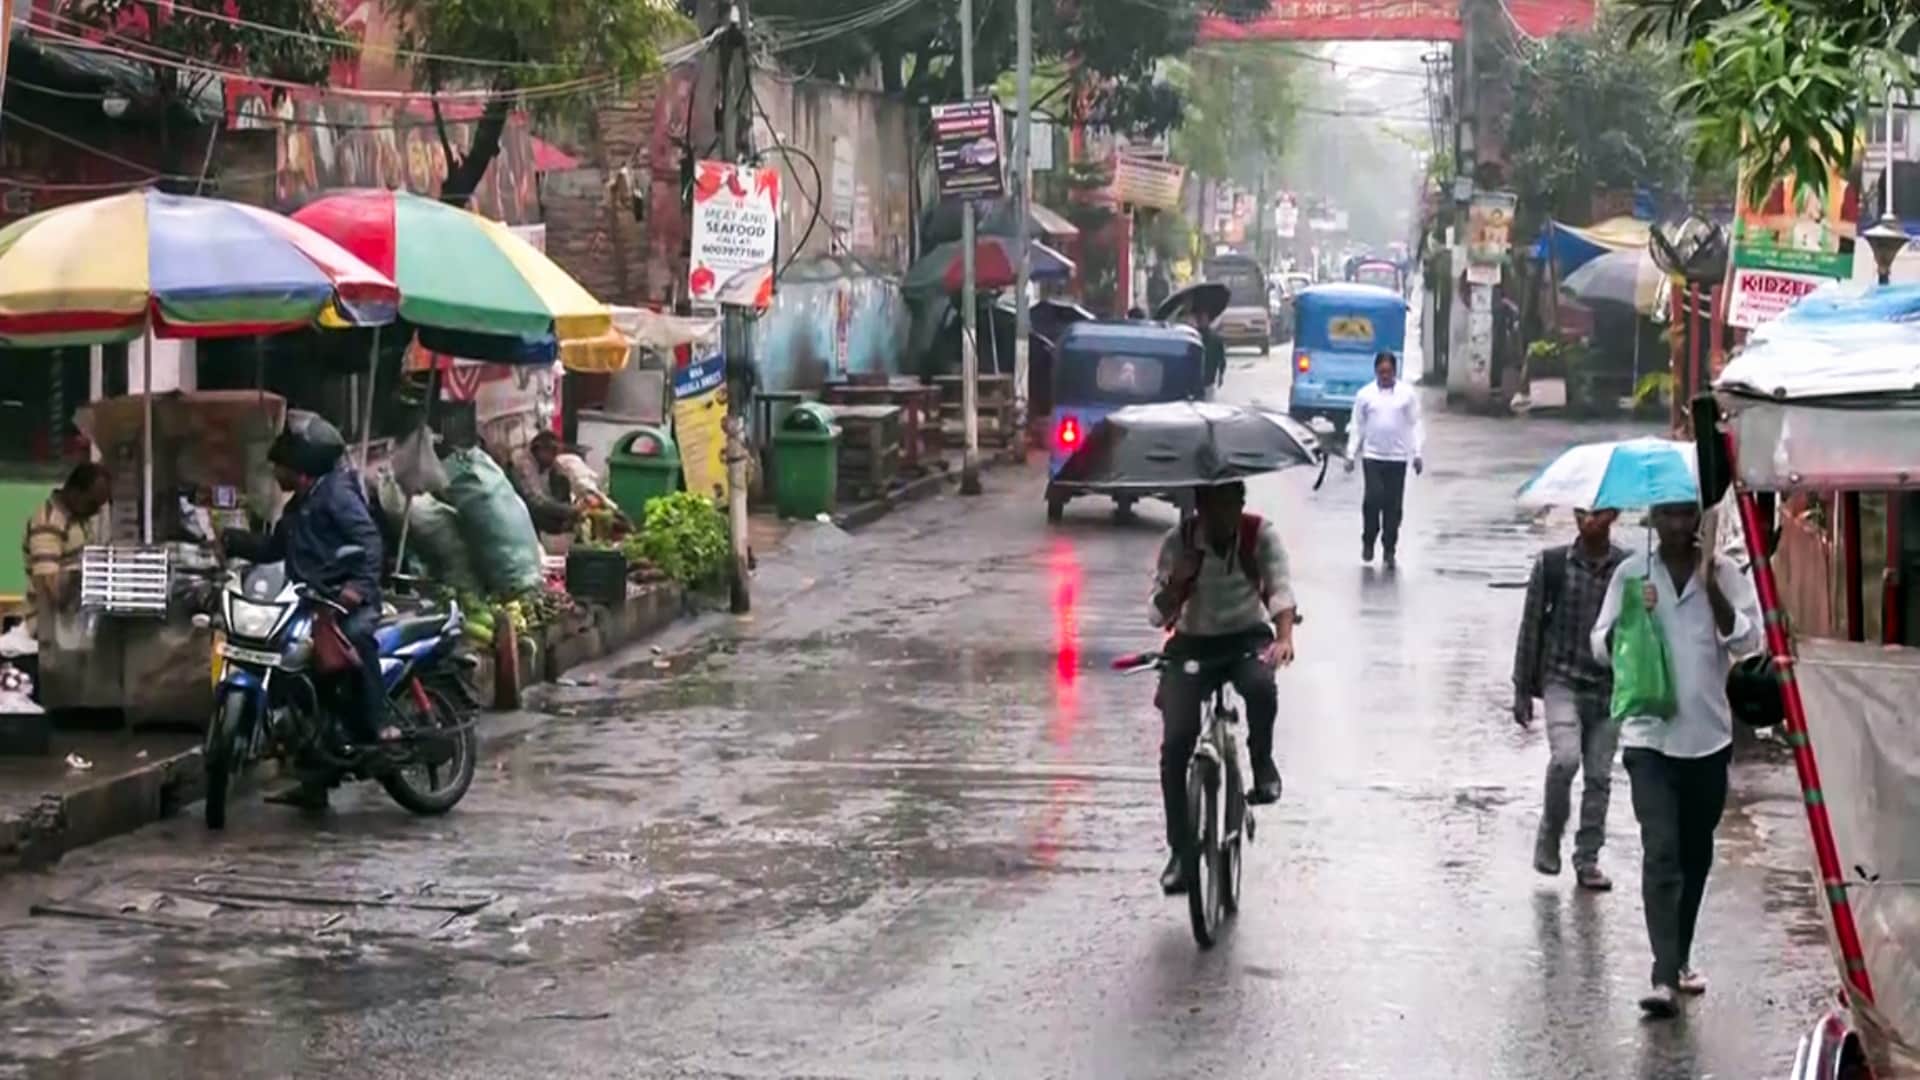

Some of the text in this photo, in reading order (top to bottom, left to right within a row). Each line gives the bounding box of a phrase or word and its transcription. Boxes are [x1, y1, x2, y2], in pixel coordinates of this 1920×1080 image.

[704, 207, 767, 224] MEAT AND
[705, 221, 766, 237] SEAFOOD
